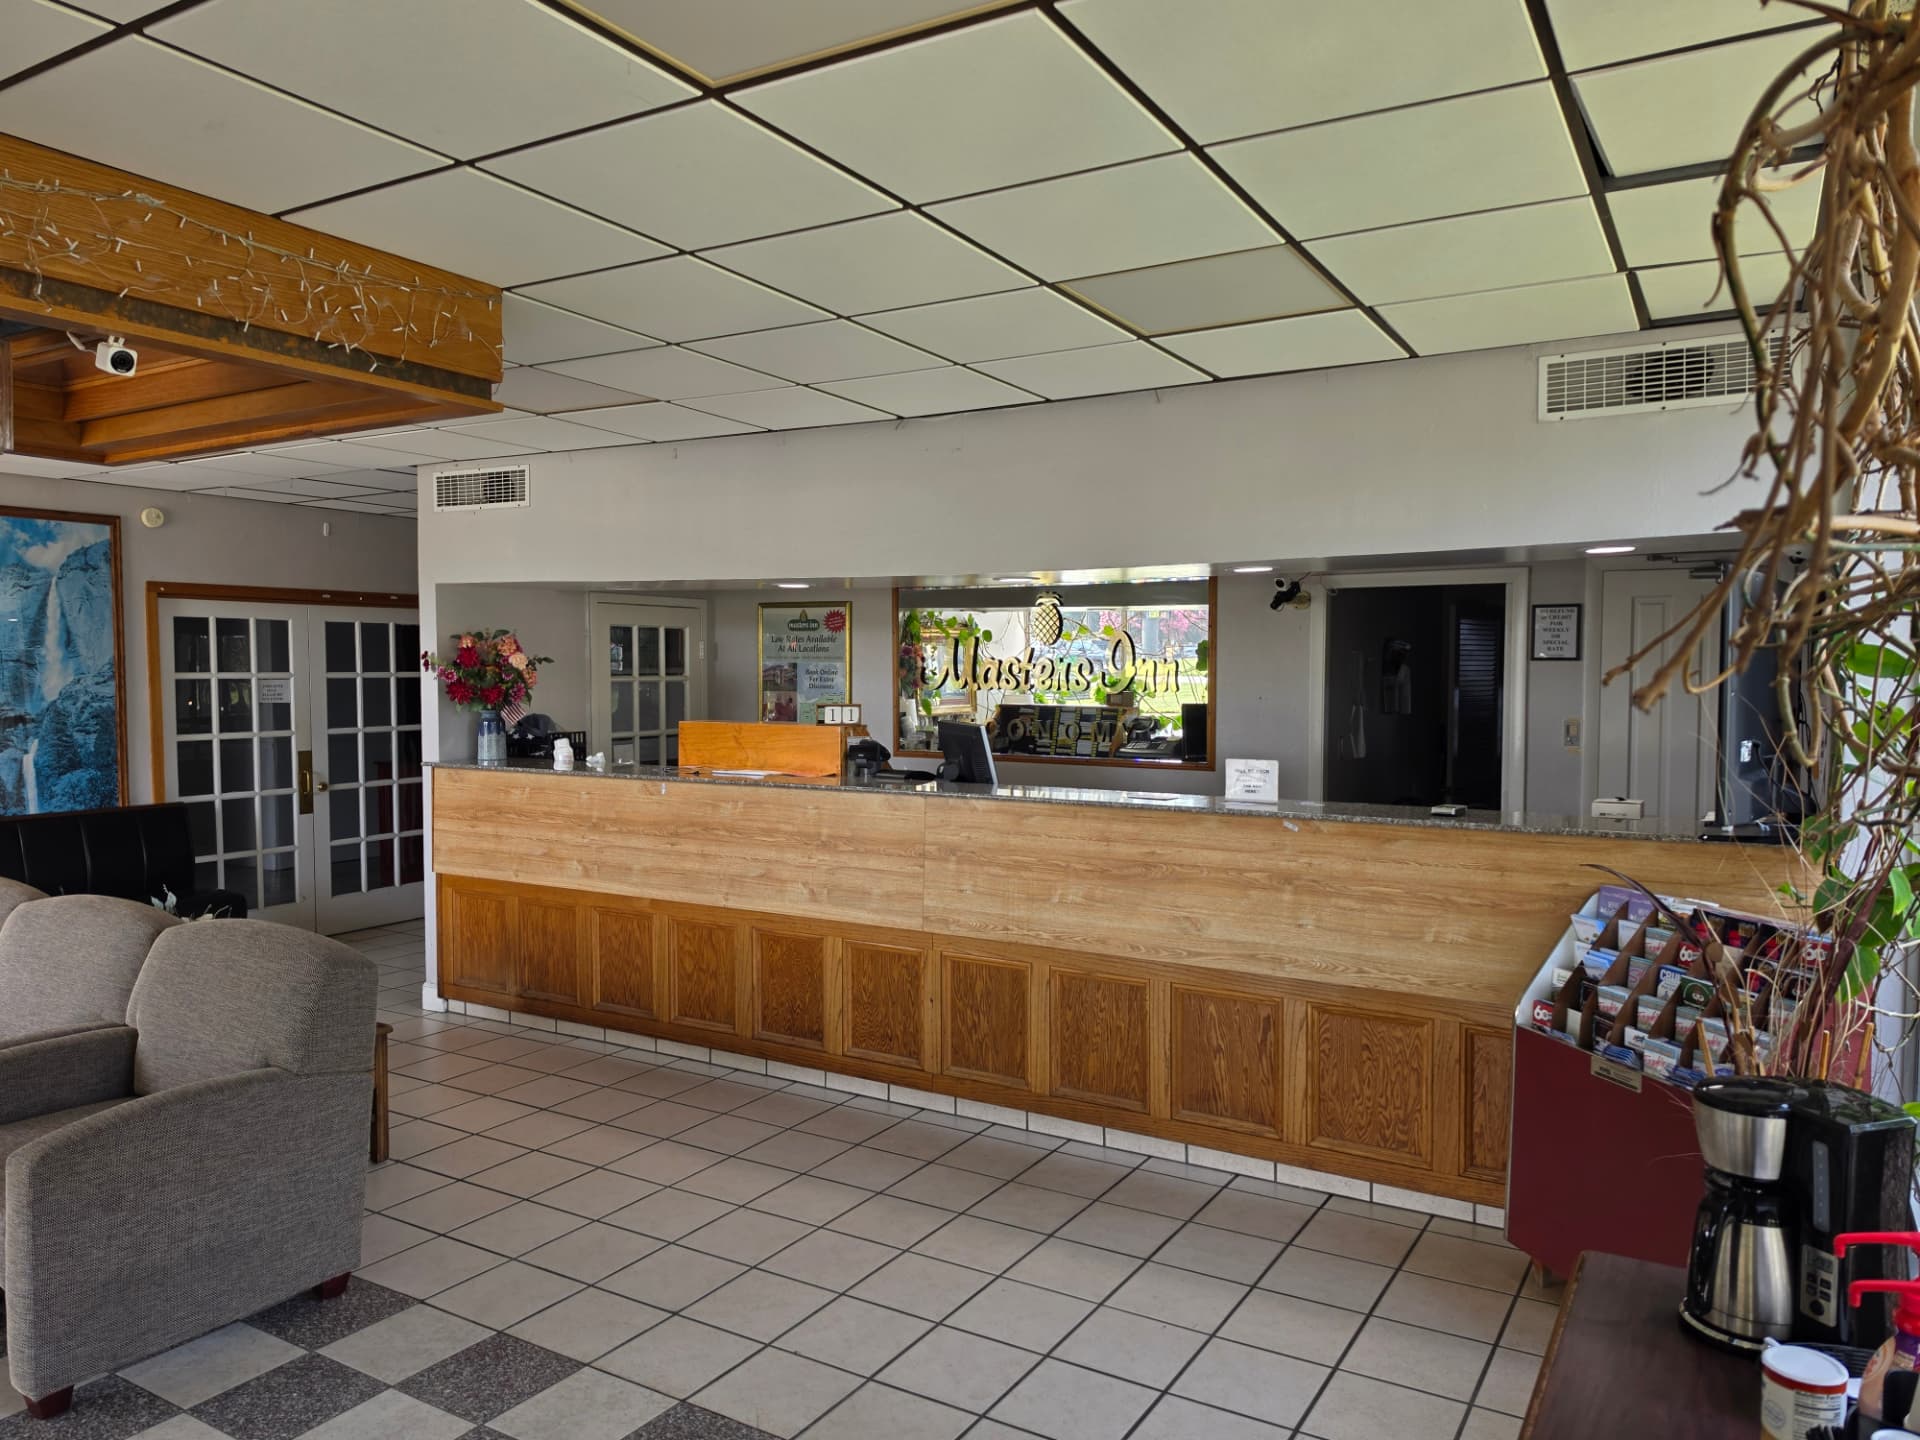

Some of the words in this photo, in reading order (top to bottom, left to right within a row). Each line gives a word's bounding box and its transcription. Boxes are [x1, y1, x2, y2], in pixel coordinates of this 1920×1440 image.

[806, 634, 837, 643] Available
[799, 645, 830, 653] Locations
[921, 636, 1093, 691] Masters
[1101, 630, 1181, 694] Inn
